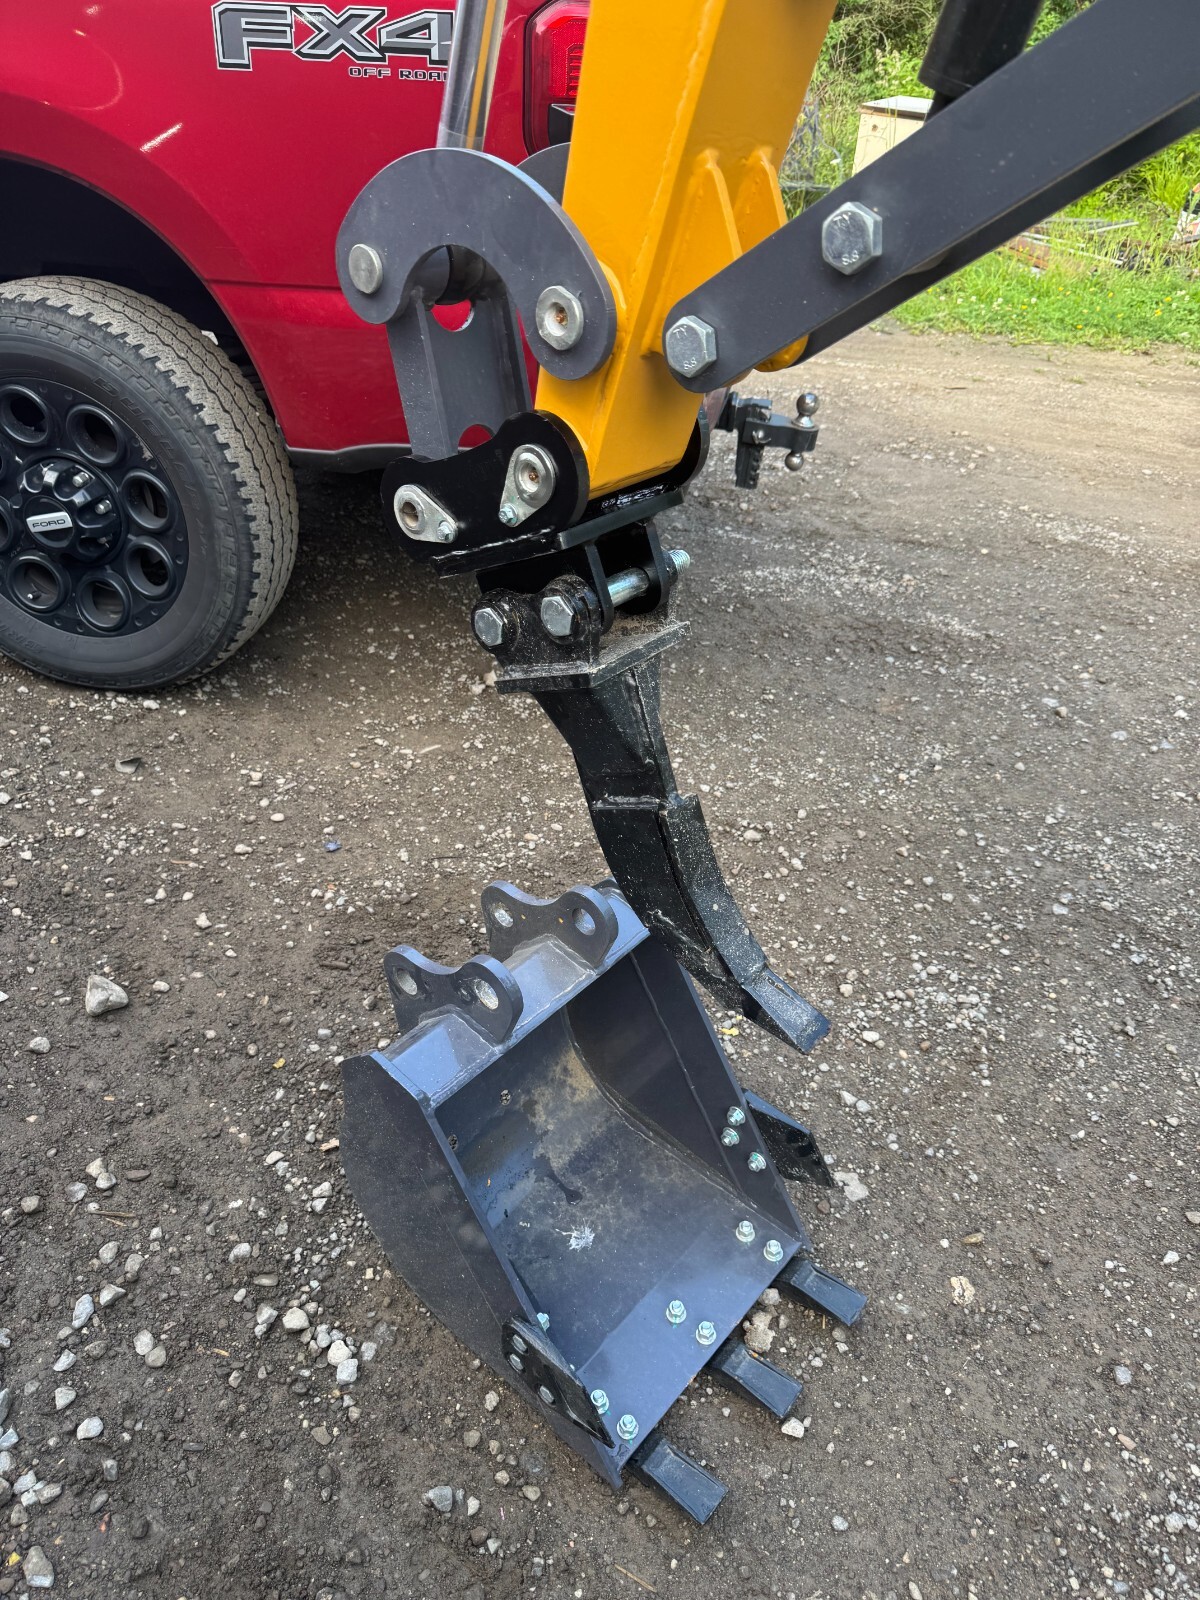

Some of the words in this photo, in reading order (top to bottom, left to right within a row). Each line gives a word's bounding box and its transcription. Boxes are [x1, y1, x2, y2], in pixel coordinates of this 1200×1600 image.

[211, 1, 455, 71] FX4
[348, 67, 391, 79] OFF
[399, 69, 448, 81] ROA
[32, 518, 66, 528] FORD
